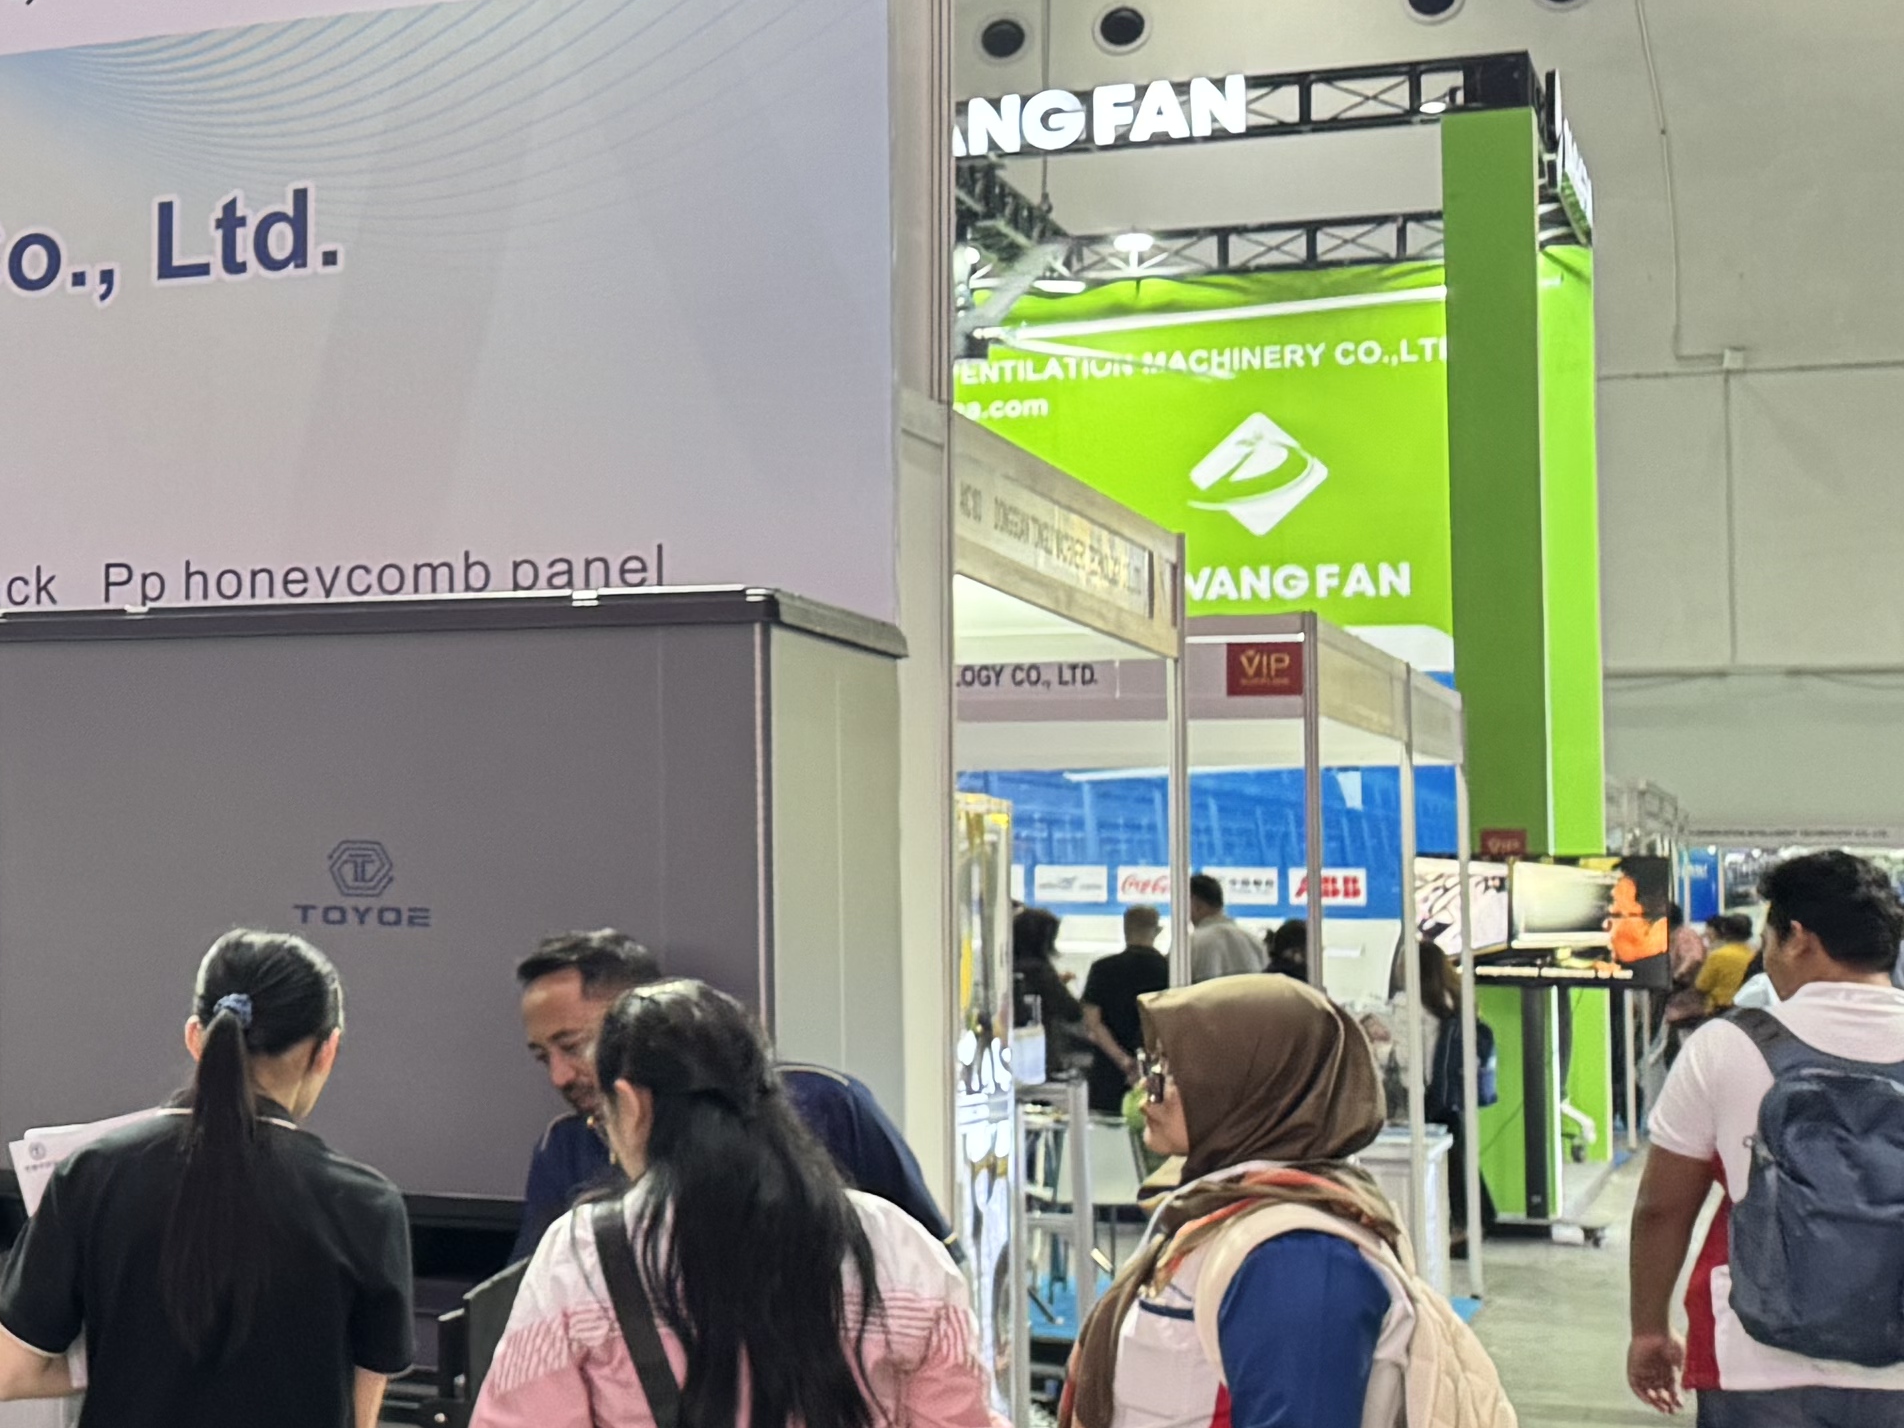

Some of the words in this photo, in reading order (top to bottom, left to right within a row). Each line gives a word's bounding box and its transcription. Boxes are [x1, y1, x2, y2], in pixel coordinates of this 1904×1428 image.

[155, 187, 341, 281] Ltd.
[953, 356, 1133, 386] ENTILATION
[1142, 343, 1325, 377] MACHINERY
[102, 561, 166, 608] Pp
[183, 550, 493, 602] honeycomb
[511, 543, 666, 593] panel
[1325, 560, 1412, 597] FAN
[956, 664, 1005, 688] OGY
[1240, 648, 1290, 676] VIP
[292, 903, 432, 928] TOYOE
